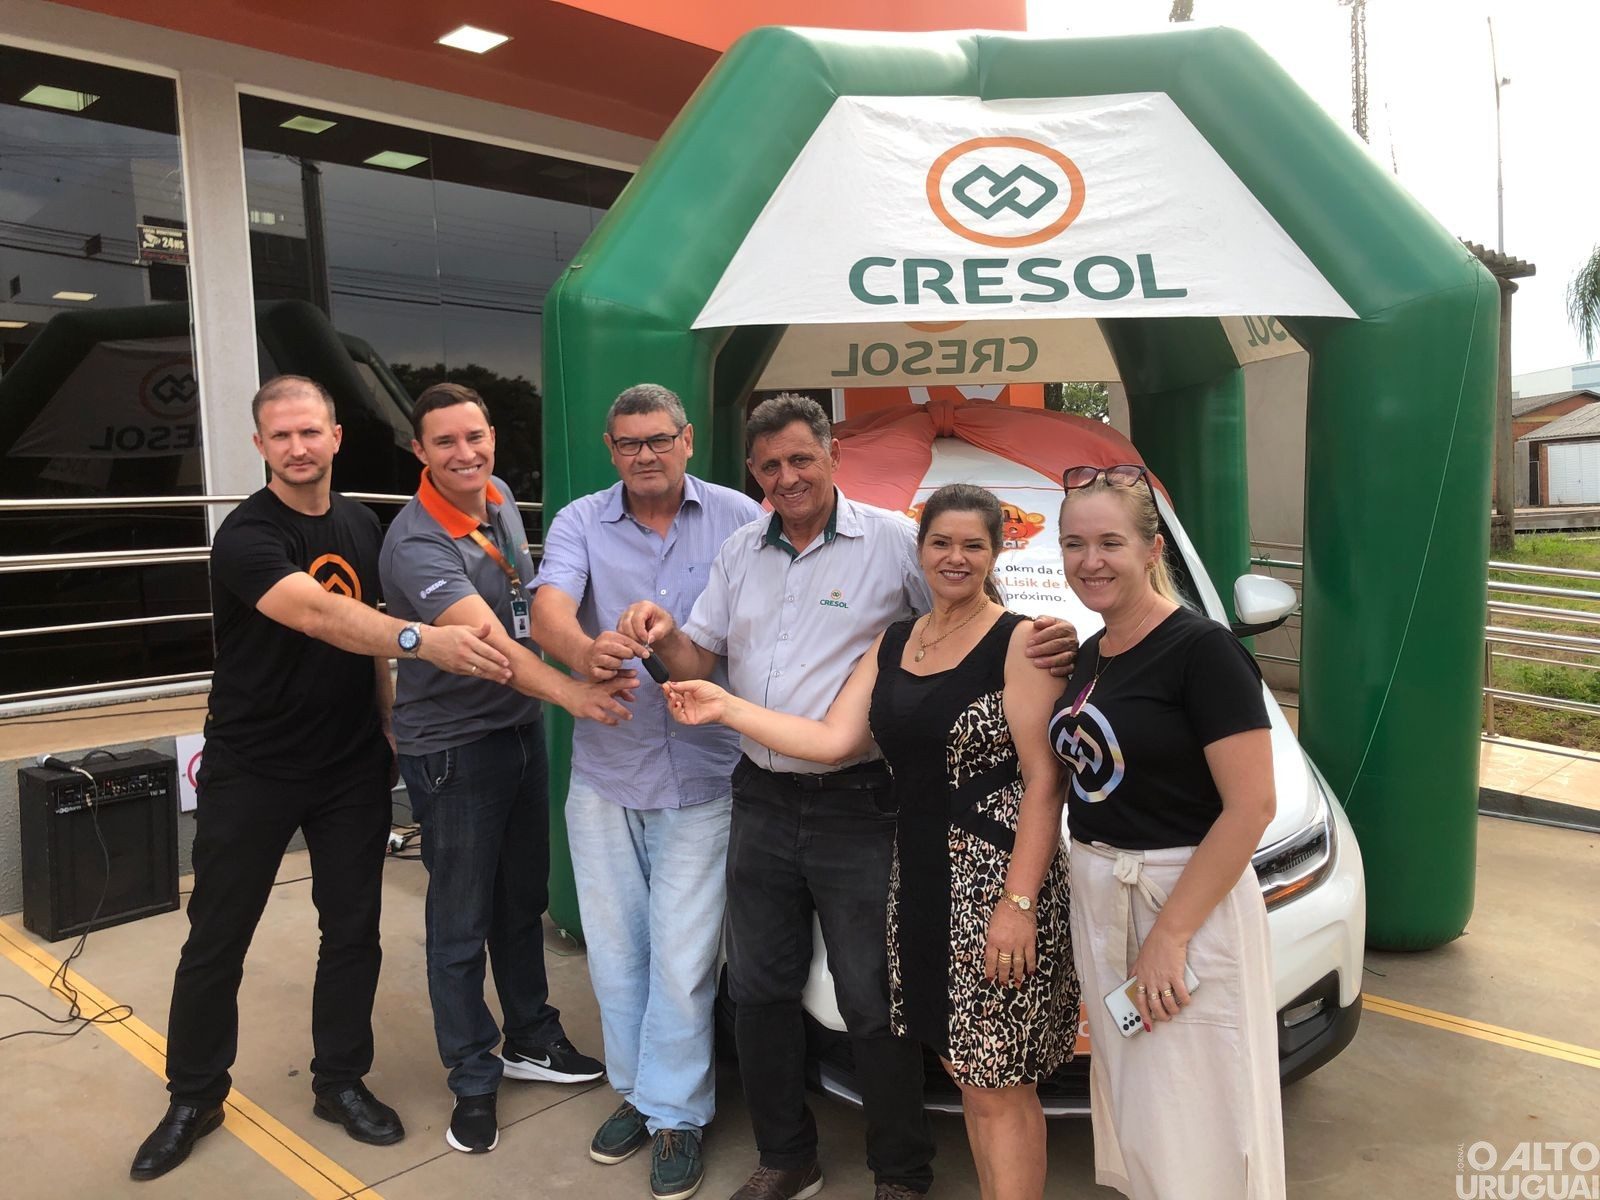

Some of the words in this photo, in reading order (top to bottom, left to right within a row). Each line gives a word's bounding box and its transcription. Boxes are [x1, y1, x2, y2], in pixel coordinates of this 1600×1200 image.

[848, 253, 1188, 305] CRESOL
[1037, 565, 1053, 575] da
[1005, 577, 1038, 587] Lisik
[1042, 579, 1061, 588] de
[1006, 591, 1066, 602] próximo.
[820, 599, 848, 608] CRESOL
